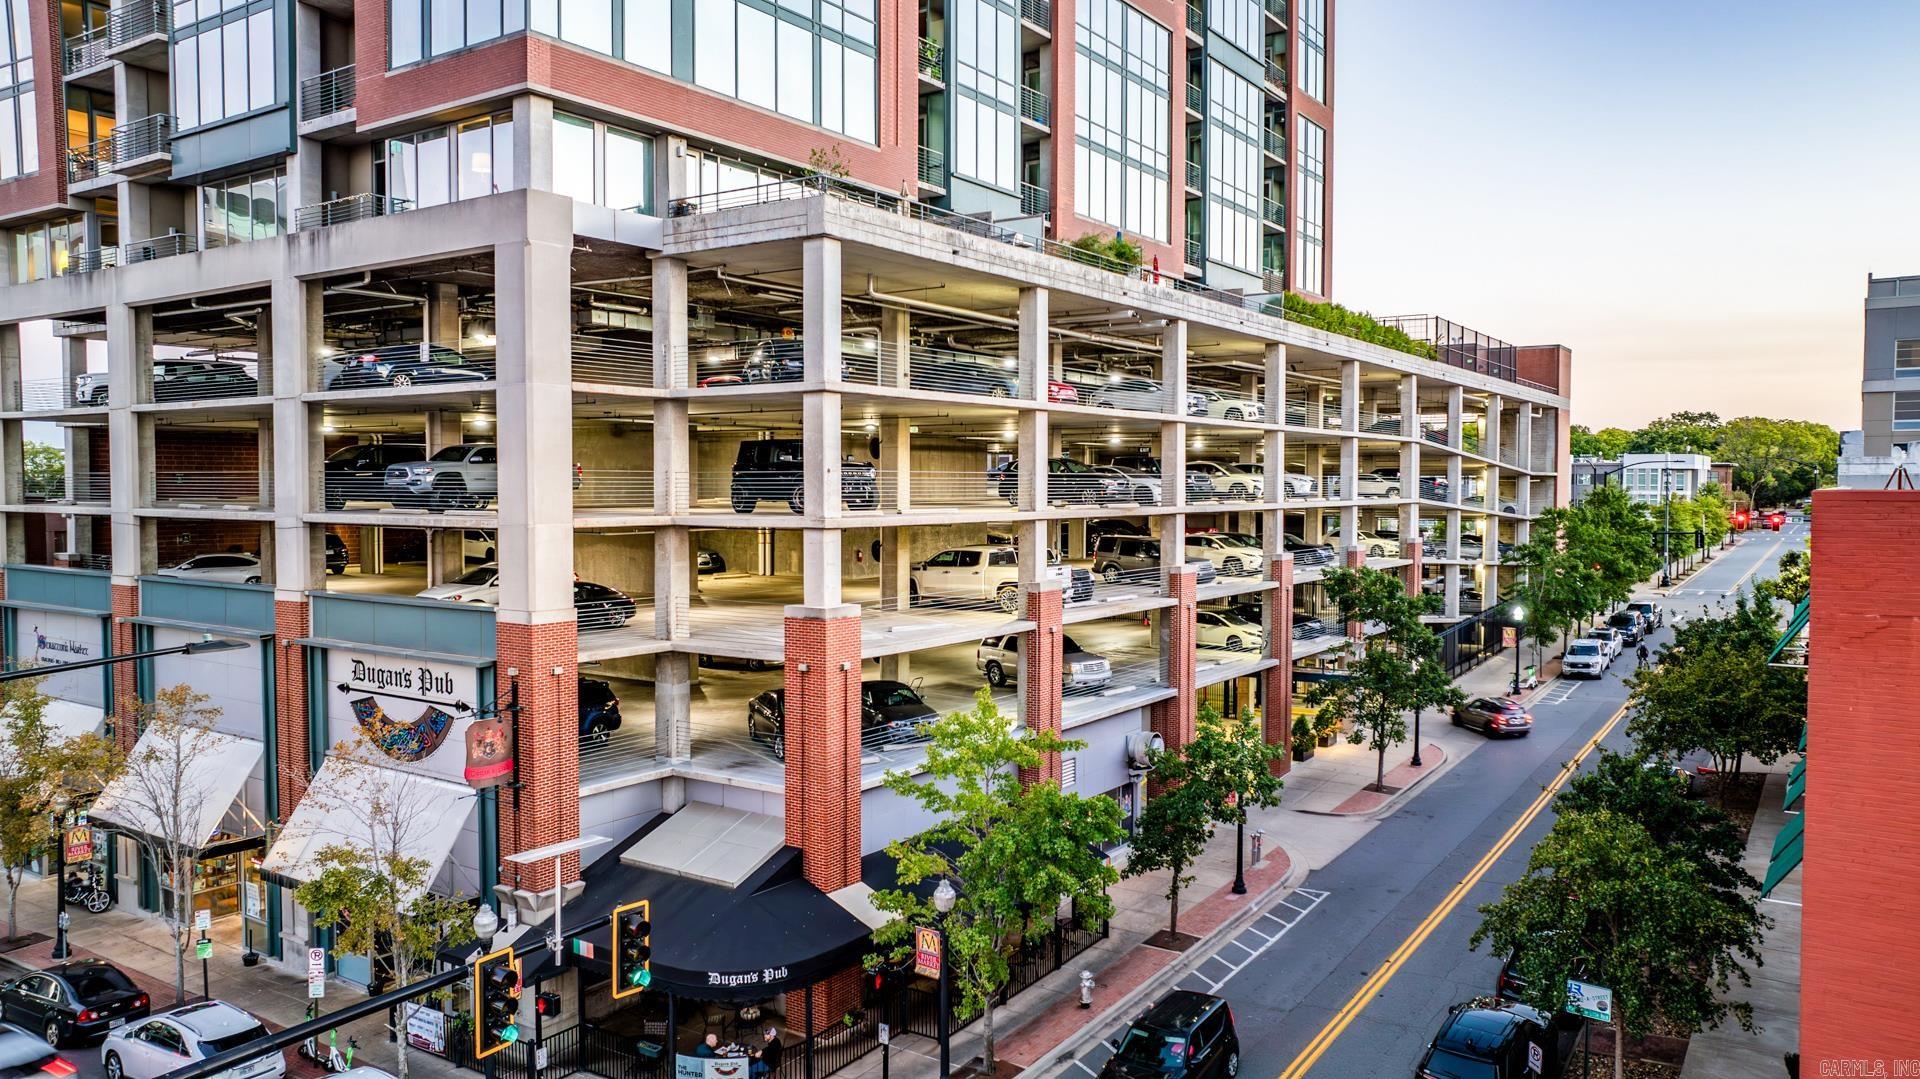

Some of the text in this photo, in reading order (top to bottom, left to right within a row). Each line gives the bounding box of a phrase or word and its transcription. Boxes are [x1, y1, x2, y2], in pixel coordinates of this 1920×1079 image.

[351, 658, 453, 696] Dugan's Pub
[917, 958, 940, 970] MARKET
[920, 953, 938, 963] RIVER
[708, 966, 788, 987] Dugan's Pub
[677, 1069, 703, 1078] HUNTER
